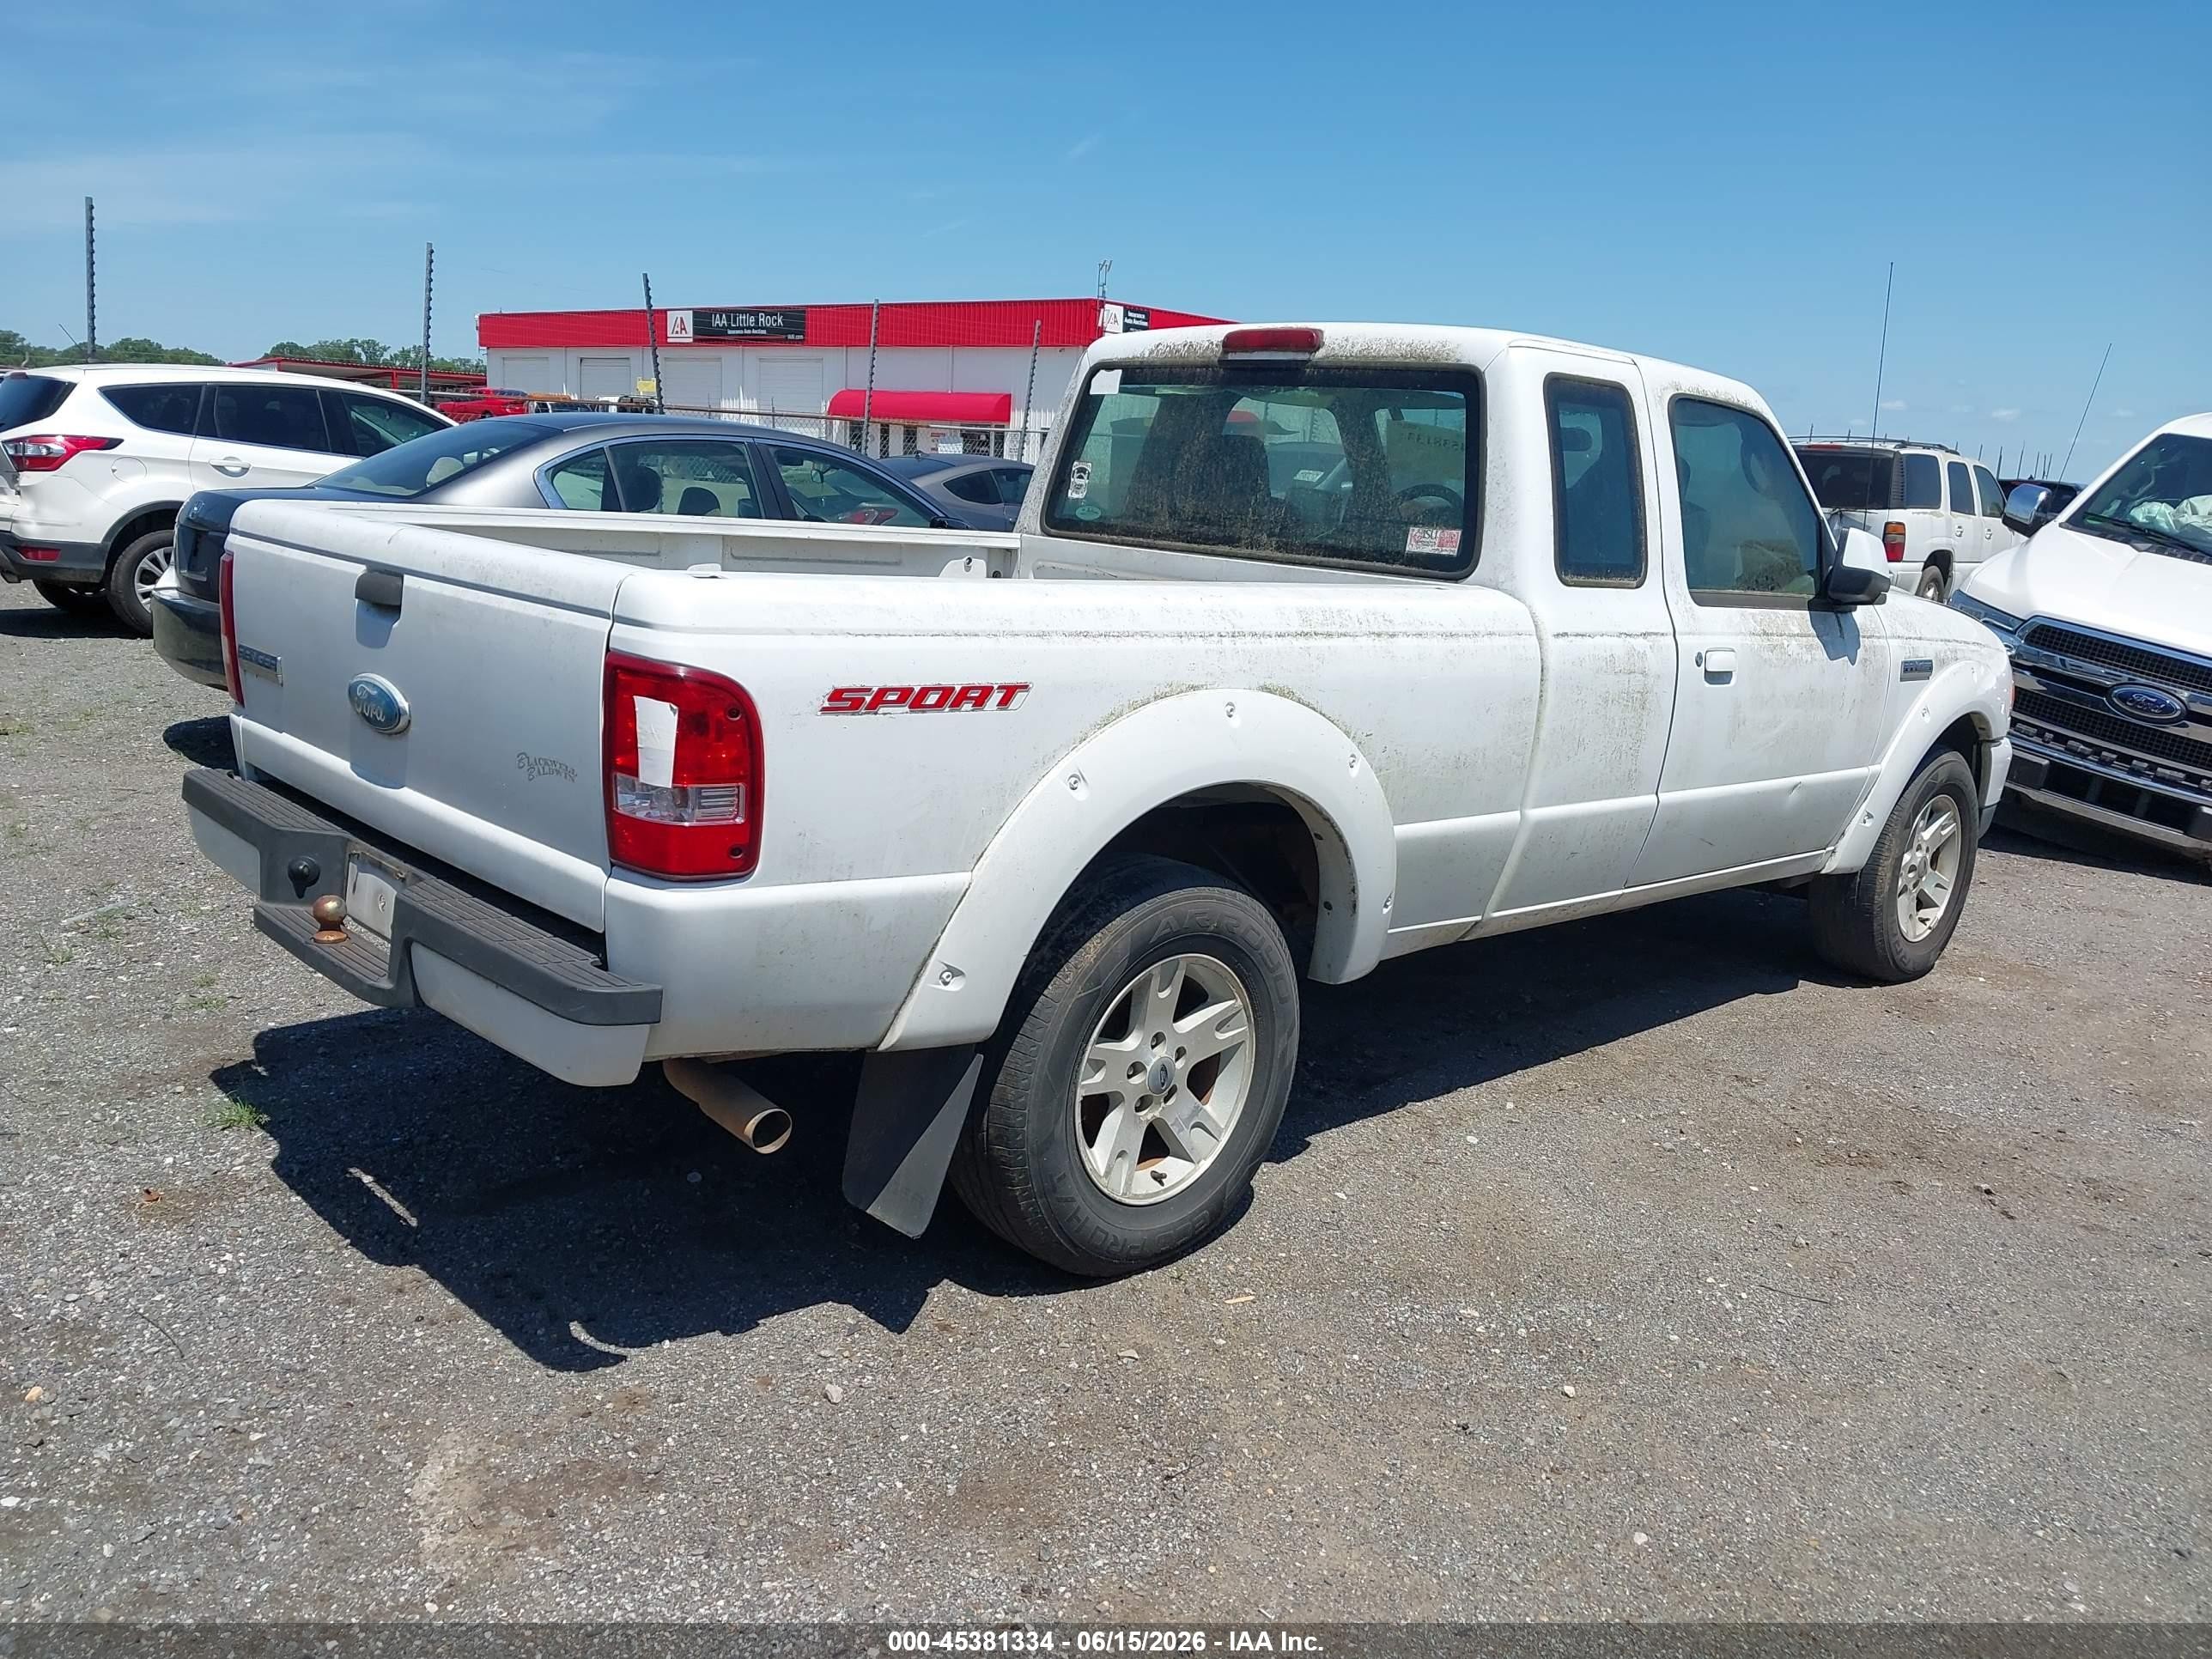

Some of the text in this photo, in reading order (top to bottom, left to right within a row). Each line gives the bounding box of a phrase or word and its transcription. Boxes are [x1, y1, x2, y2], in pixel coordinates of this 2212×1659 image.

[712, 312, 783, 327] IAA Little Rock
[818, 684, 1030, 714] SPORT
